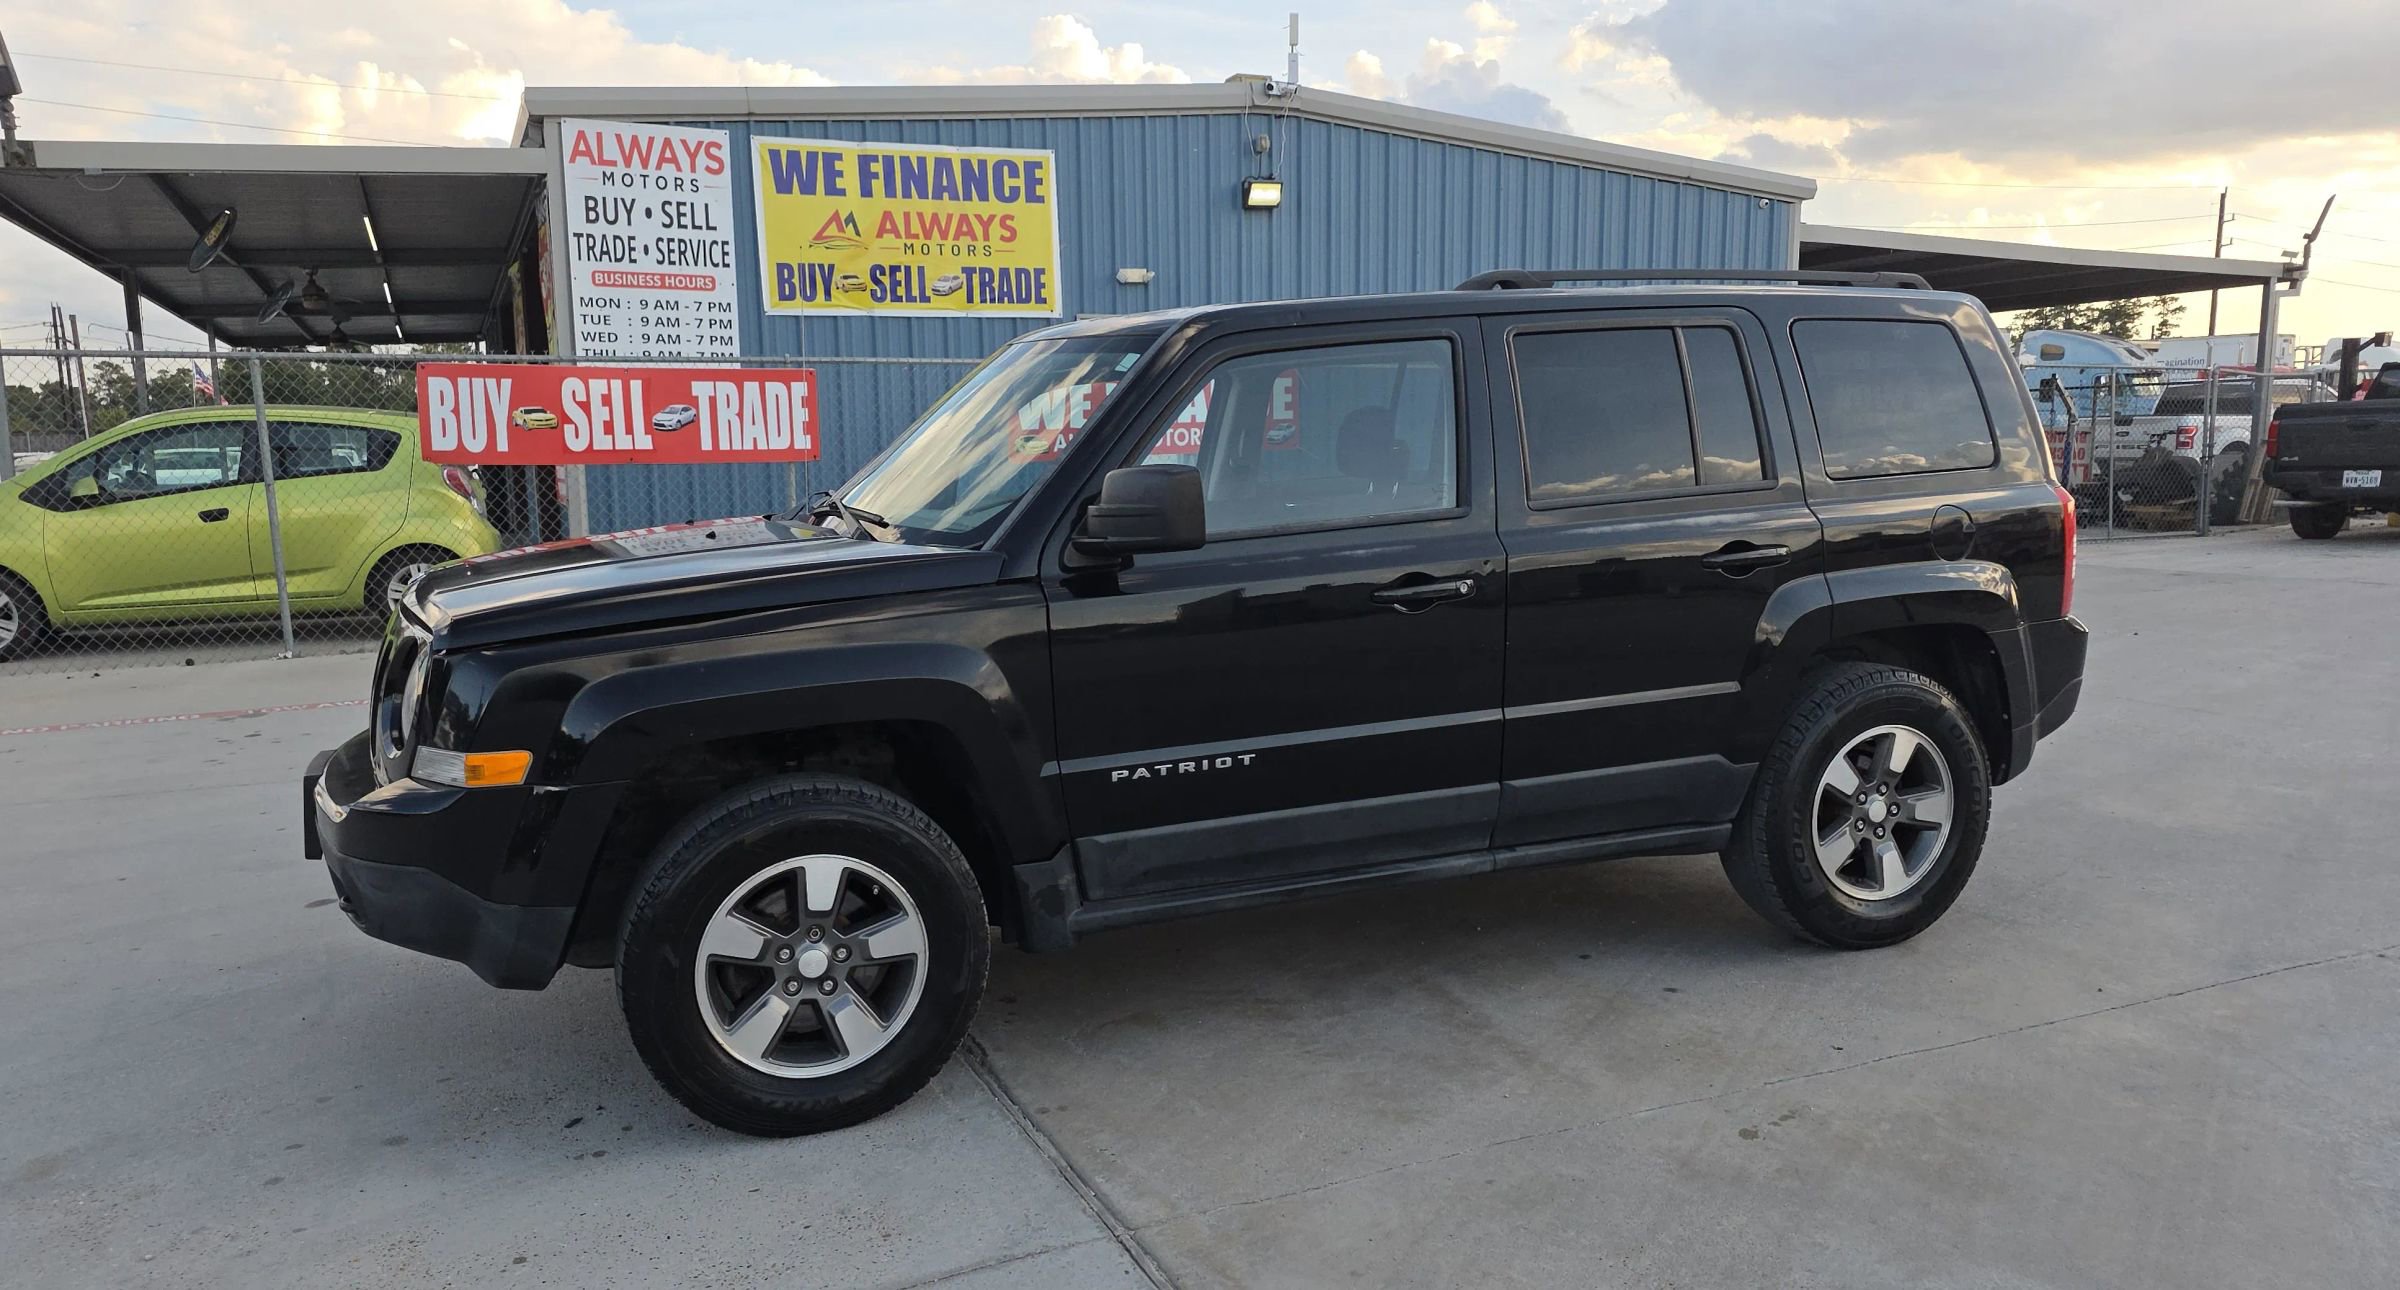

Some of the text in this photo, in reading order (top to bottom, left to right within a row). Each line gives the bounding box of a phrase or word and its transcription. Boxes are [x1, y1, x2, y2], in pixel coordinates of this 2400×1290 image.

[568, 129, 725, 175] ALWAYS
[602, 170, 700, 193] MOTORS
[767, 149, 1046, 204] WE FINANCE
[584, 195, 718, 231] BUY SELL
[875, 210, 1018, 243] ALWAYS
[573, 232, 731, 268] TRADE SERVICE
[904, 243, 992, 257] MOTORS
[594, 272, 713, 289] BUSINESS HOURS
[776, 263, 1047, 305] BUY SELL TRADE
[579, 296, 621, 309] MON
[639, 299, 649, 310] 9
[653, 300, 679, 311] AM
[693, 301, 702, 312] 7
[708, 301, 732, 313] PM
[579, 313, 612, 326] TUE
[640, 316, 649, 327] 9
[654, 316, 680, 328] AM
[694, 318, 703, 329] 7
[709, 318, 733, 330] PM
[581, 331, 618, 343] WED
[641, 333, 650, 344] 9
[655, 333, 681, 345] AM
[695, 335, 704, 346] 7
[710, 335, 733, 347] PM
[582, 348, 616, 357] THU
[427, 376, 812, 454] BUY SELL TRADE
[1018, 383, 1092, 430] WE
[1111, 753, 1256, 782] PATRIOT
